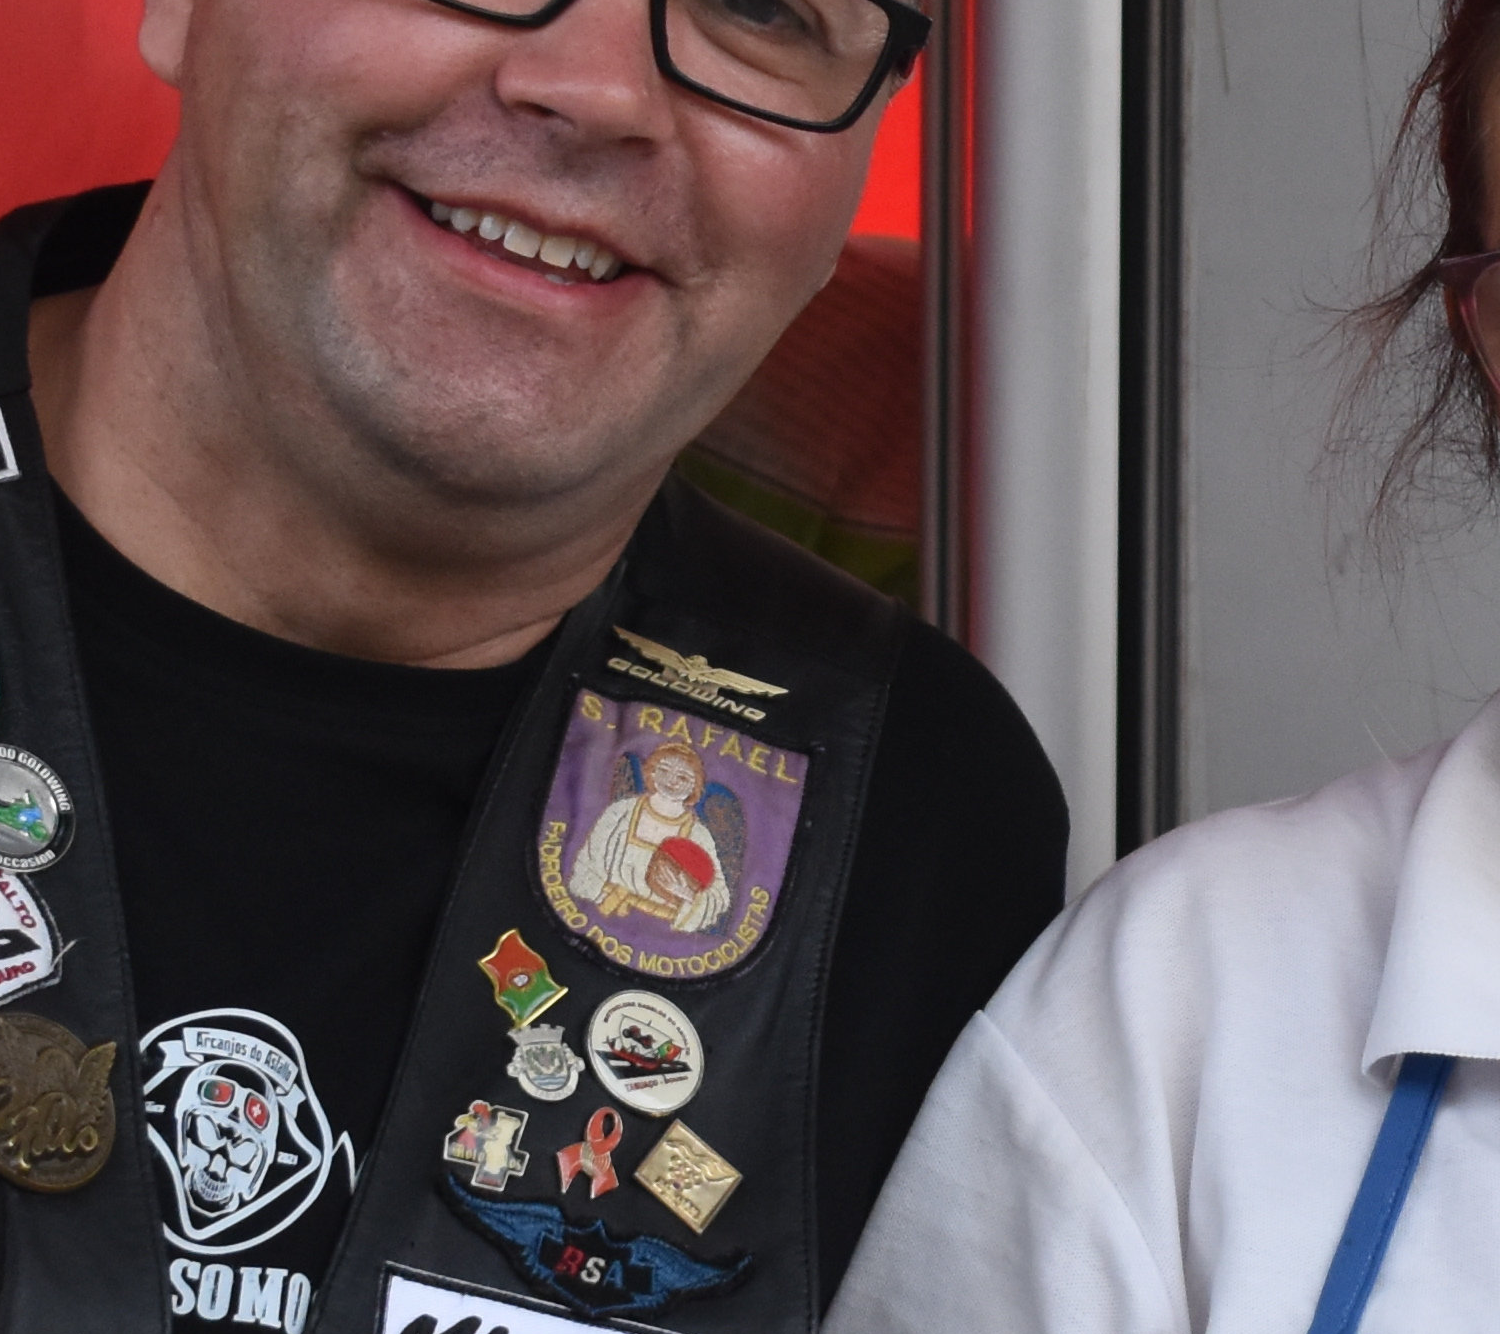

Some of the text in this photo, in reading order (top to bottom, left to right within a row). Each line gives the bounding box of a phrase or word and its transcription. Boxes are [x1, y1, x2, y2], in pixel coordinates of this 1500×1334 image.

[606, 656, 767, 721] GOLDWING
[580, 694, 799, 785] S. RAFAEL
[18, 752, 71, 811] GOLDWING
[586, 924, 634, 969] DOS
[638, 885, 771, 976] MOTOCICLISTAS
[196, 1030, 248, 1057] Arcanjos
[250, 1044, 263, 1063] do
[555, 1244, 624, 1290] RSA
